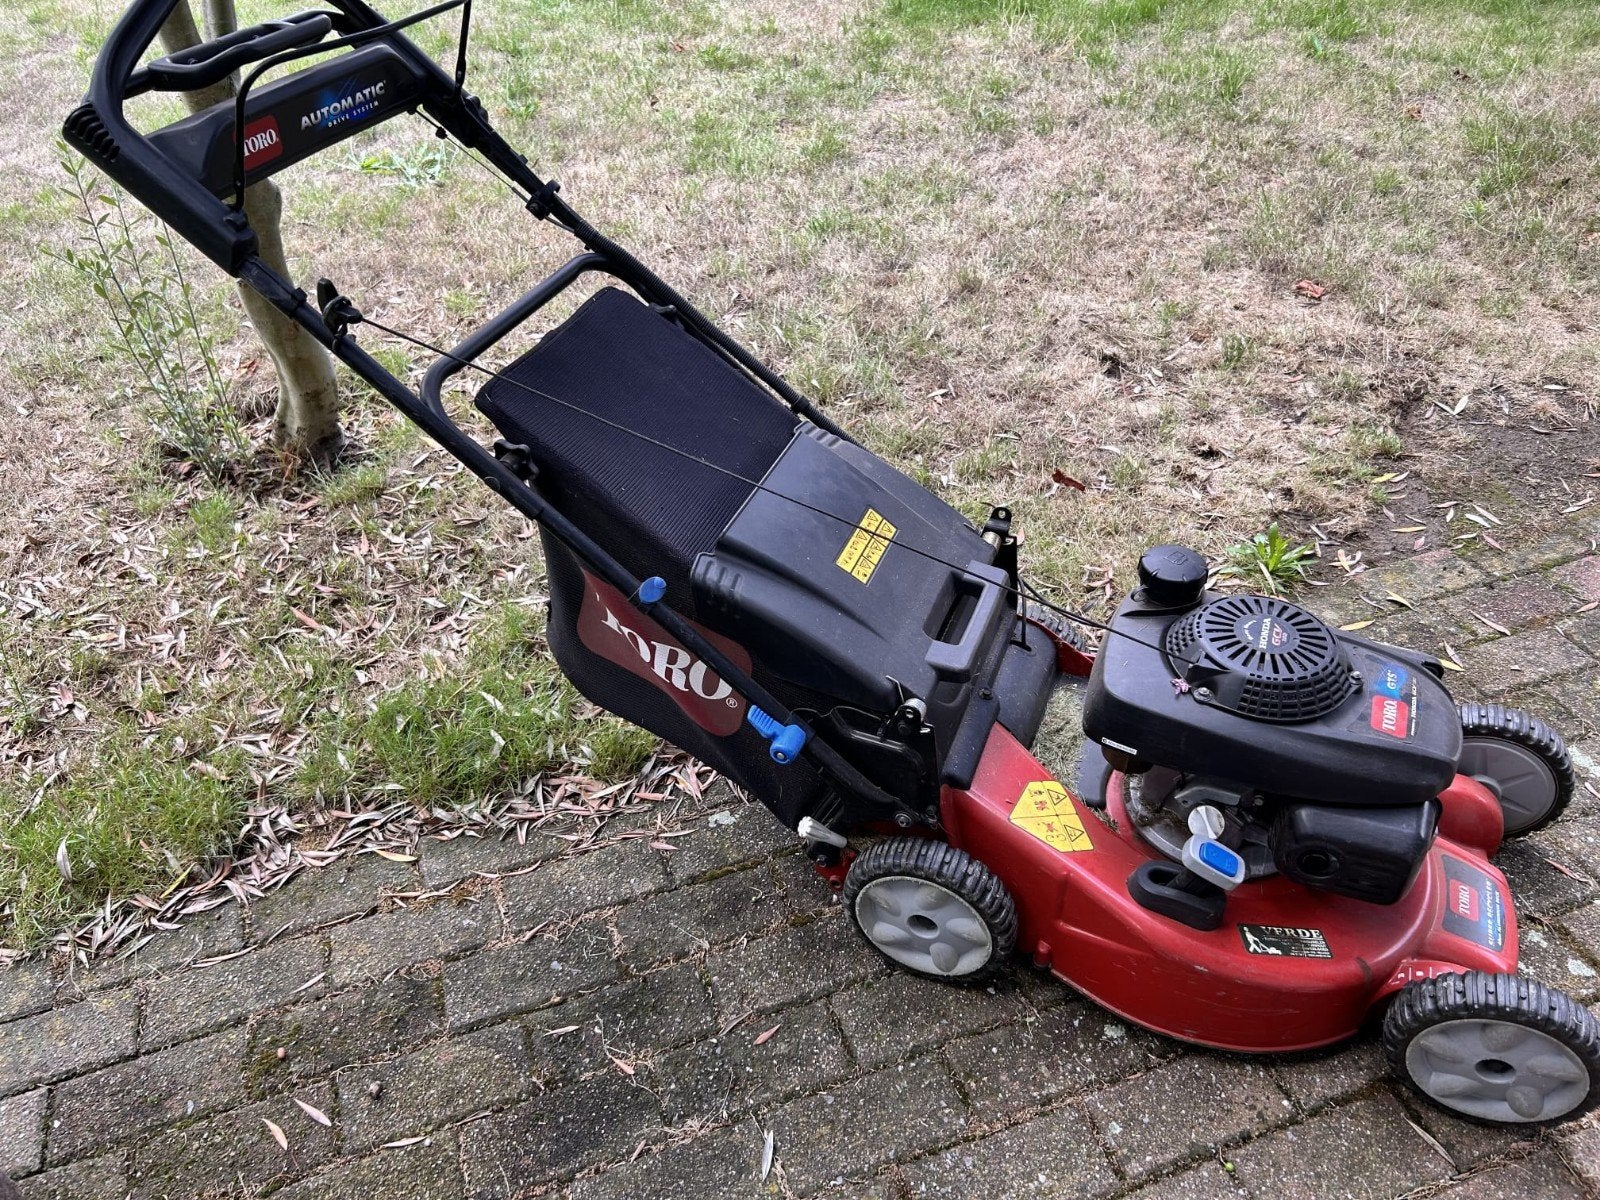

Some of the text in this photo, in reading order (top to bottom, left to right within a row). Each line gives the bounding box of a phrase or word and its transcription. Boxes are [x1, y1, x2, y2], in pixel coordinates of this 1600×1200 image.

[301, 82, 386, 130] AUTOMATIC
[328, 101, 379, 128] DRIVE SYSTEM
[1259, 618, 1271, 649] HONDA
[1272, 623, 1282, 646] GCV
[1387, 671, 1397, 690] GTS
[1382, 700, 1398, 731] TORO
[1459, 885, 1470, 915] TORO
